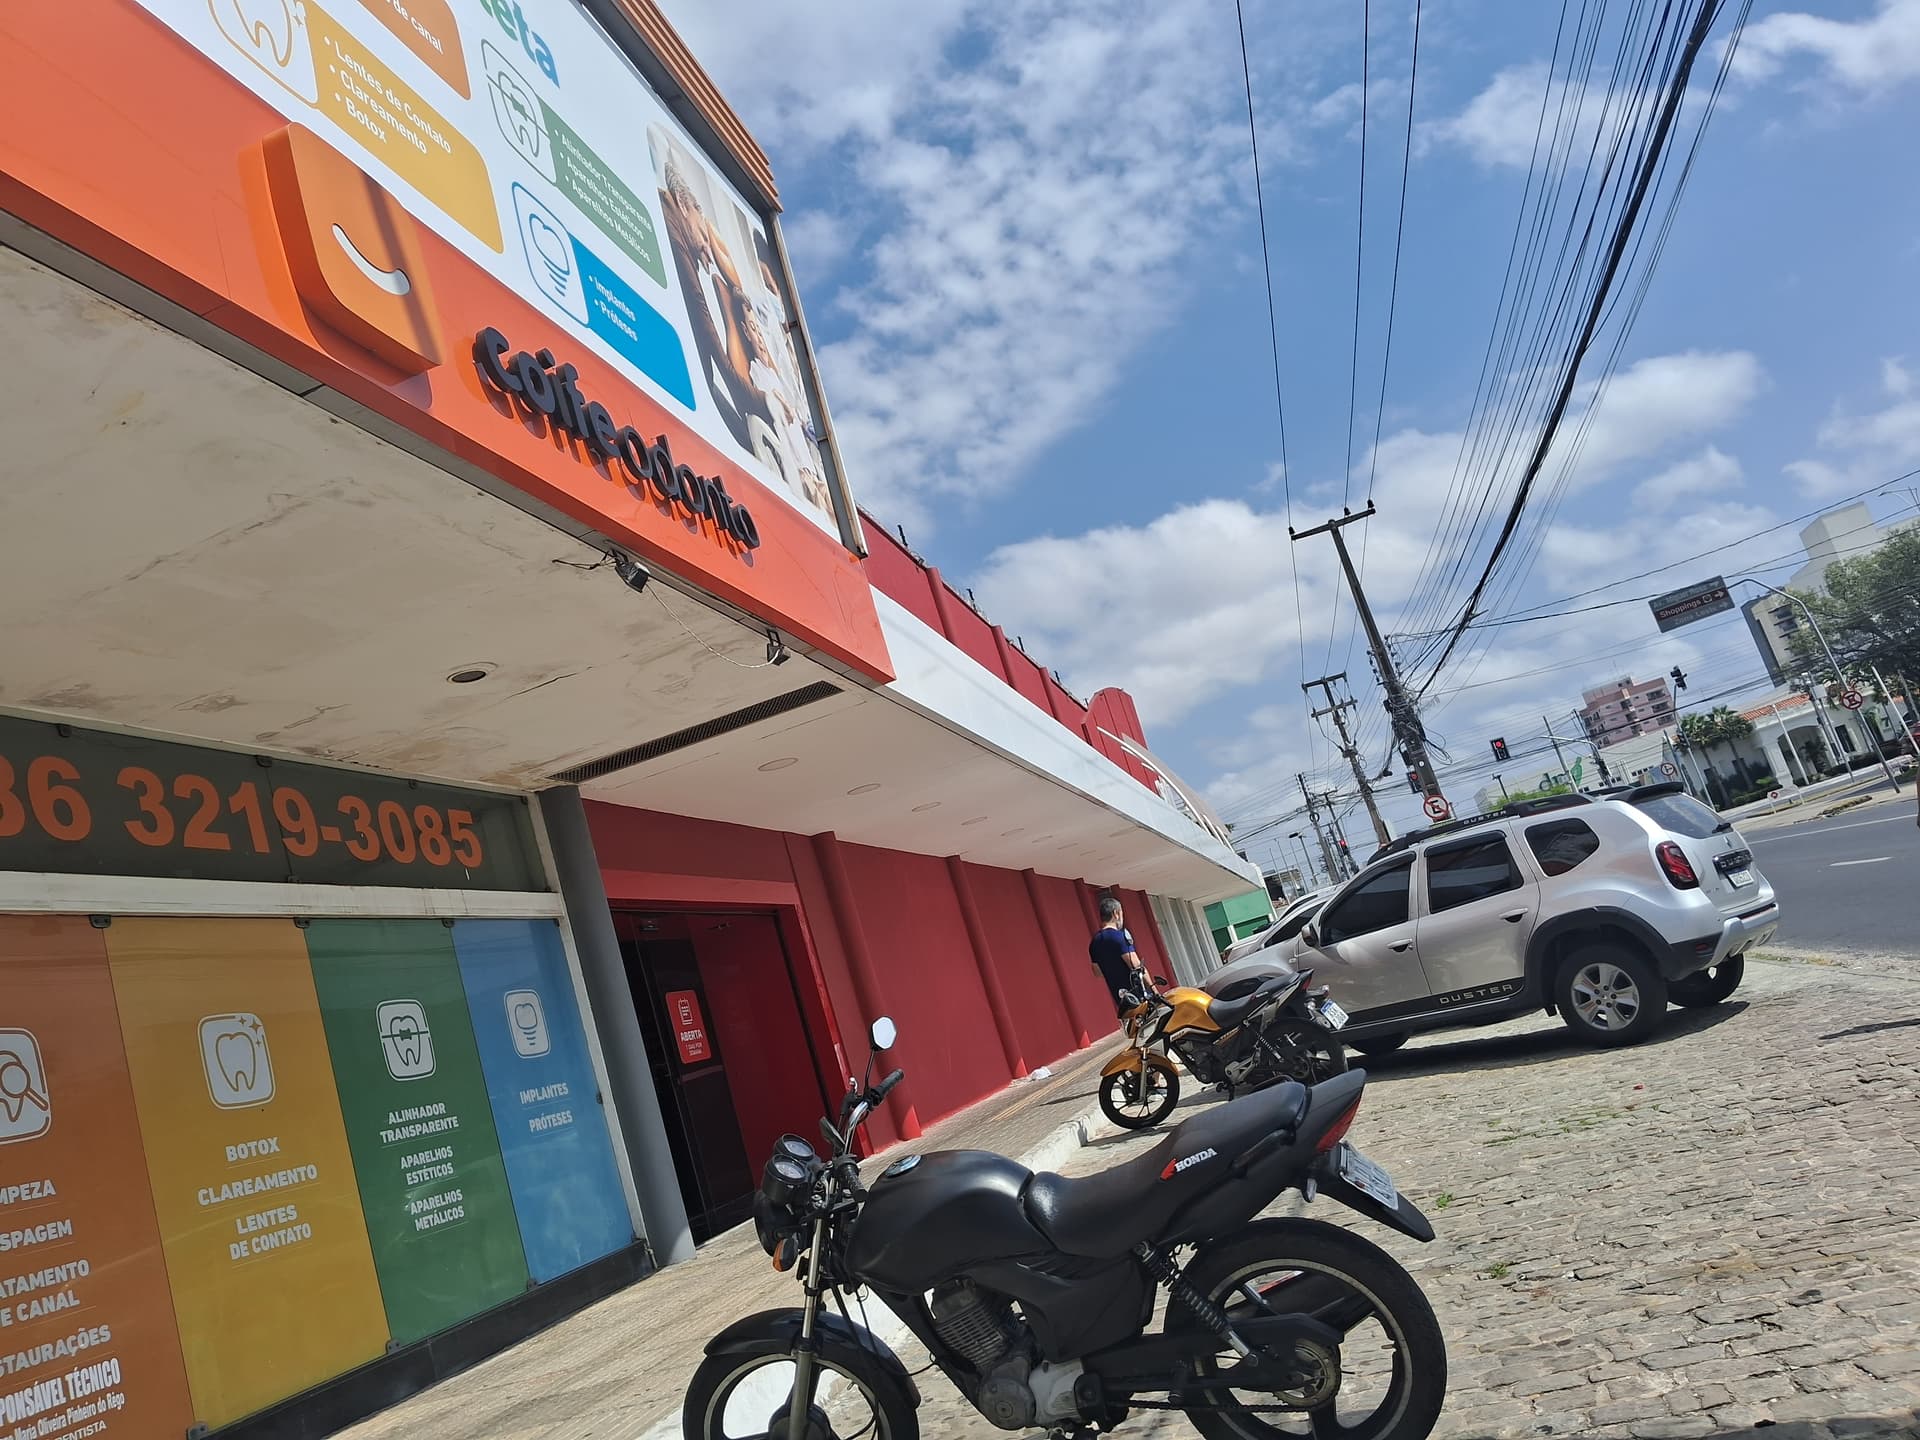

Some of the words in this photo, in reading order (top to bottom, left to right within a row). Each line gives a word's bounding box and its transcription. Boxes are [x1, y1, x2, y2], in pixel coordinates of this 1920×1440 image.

[410, 17, 444, 55] canal
[335, 40, 383, 95] Lentes
[385, 87, 402, 112] de
[404, 102, 452, 154] Contato
[340, 70, 427, 154] Clareamento
[345, 97, 387, 145] Botox
[595, 276, 636, 321] Implantes
[600, 300, 638, 342] Próteses
[1660, 598, 1702, 618] Shoppings
[117, 766, 483, 868] 3219-3085
[1463, 810, 1507, 825] DUSTER
[1439, 984, 1513, 1004] DUSTER
[680, 1029, 703, 1042] ABERTA
[520, 1083, 569, 1104] IMPLANTES
[388, 1102, 446, 1124] ALINHADOR
[529, 1110, 573, 1132] PRÓTESES
[380, 1116, 459, 1143] TRANSPARENTE
[225, 1137, 280, 1162] BOTOX
[400, 1146, 453, 1169] APARELHOS
[1175, 1147, 1218, 1173] HONDA
[198, 1164, 318, 1206] CLAREAMENTO
[406, 1162, 454, 1185] ESTÉTICOS
[410, 1189, 463, 1215] APARELHOS
[236, 1204, 298, 1234] LENTES
[415, 1206, 465, 1231] METÁLICOS
[229, 1240, 250, 1260] DE
[251, 1223, 312, 1254] CONTATO
[17, 1290, 80, 1321] CANAL
[65, 1358, 121, 1400] TÉCNICO
[37, 1413, 67, 1437] Oliveira
[66, 1401, 97, 1425] Pinheiro
[97, 1397, 107, 1414] do
